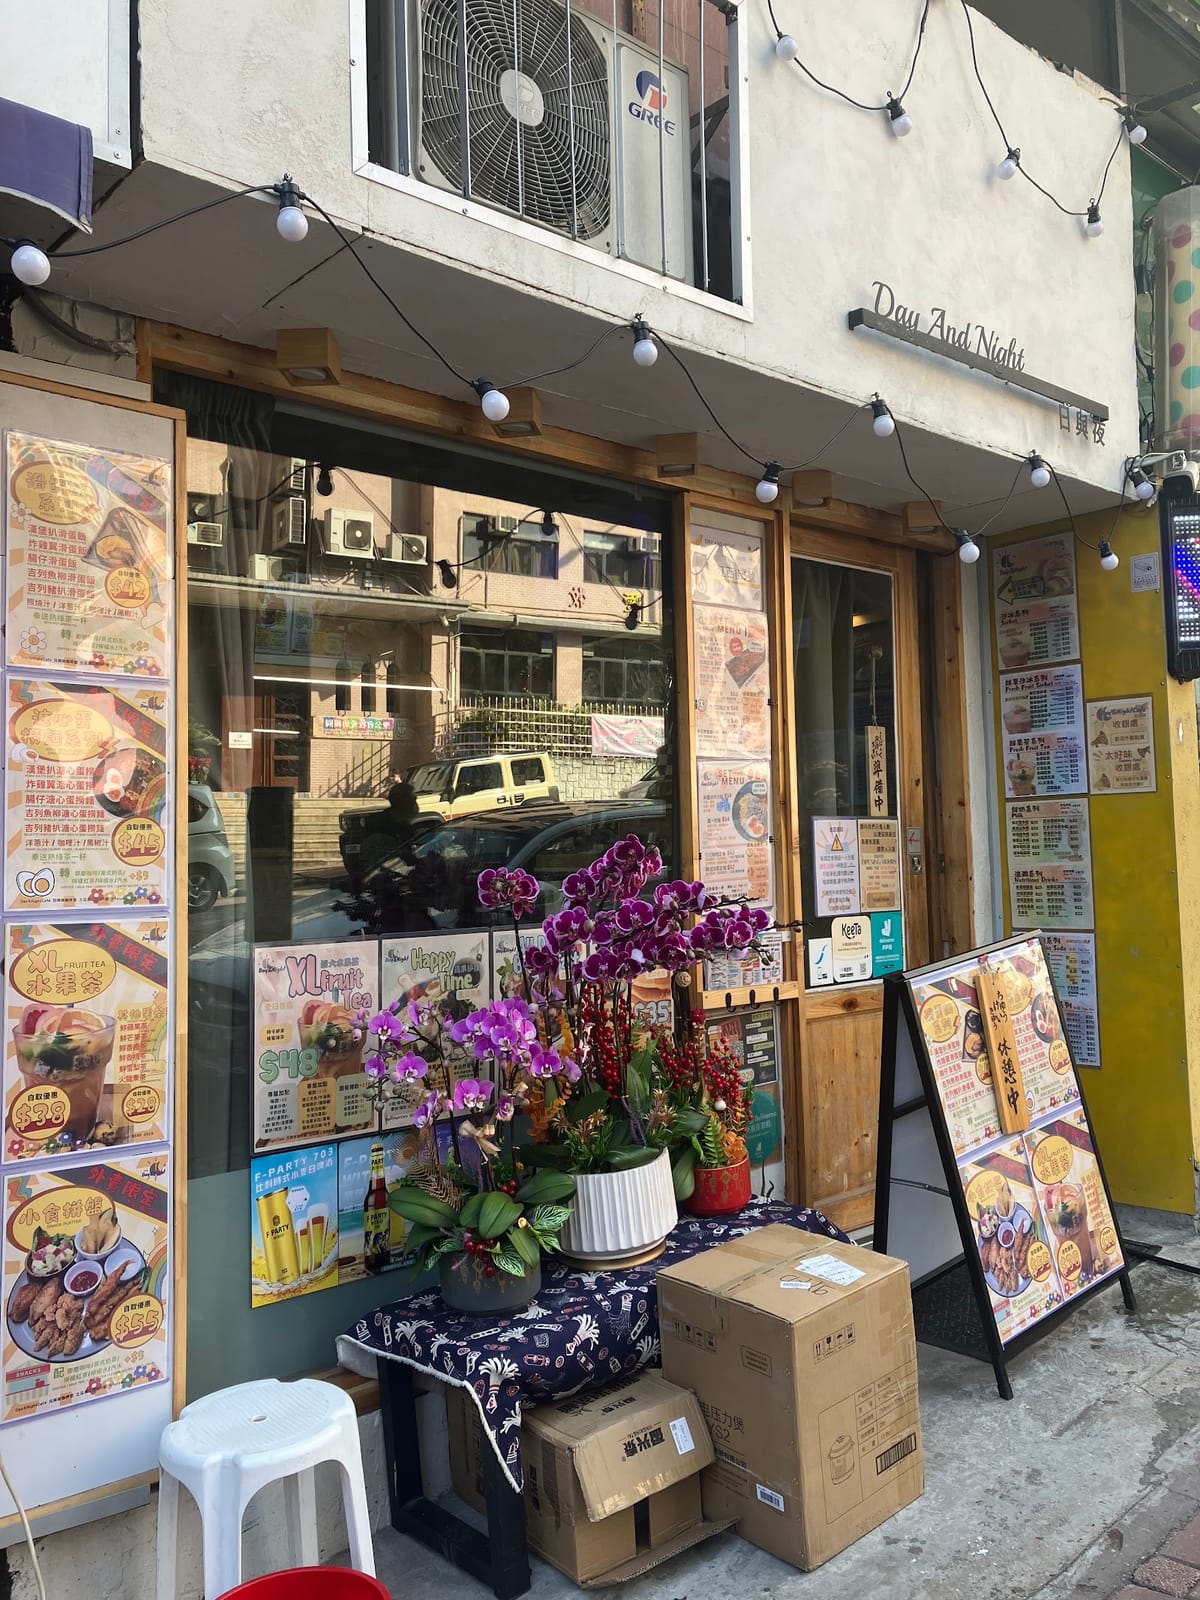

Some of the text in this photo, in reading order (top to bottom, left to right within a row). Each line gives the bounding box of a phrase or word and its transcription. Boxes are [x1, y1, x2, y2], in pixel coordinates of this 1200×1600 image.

[628, 101, 676, 136] GREE
[872, 281, 1025, 373] Day And Night
[1058, 403, 1106, 447] 日與夜
[119, 832, 160, 858] $45
[27, 950, 107, 974] XL FRUIT TEA
[411, 946, 456, 974] Happy
[26, 971, 102, 996] 水果茶
[284, 953, 323, 998] XL
[320, 968, 364, 992] Fruit
[437, 970, 474, 993] Time
[341, 989, 373, 1012] Tea
[259, 1047, 319, 1084] $48
[998, 1038, 1020, 1116] 休憩中
[16, 1103, 65, 1130] $38
[126, 1097, 156, 1115] $28
[255, 1148, 333, 1182] F-PARTY 703
[88, 1166, 159, 1206] 外賣限定
[18, 1196, 104, 1227] 小食拼盤
[370, 1211, 387, 1222] PARTY
[271, 1223, 290, 1237] PARTY
[115, 1309, 159, 1343] $55
[701, 1402, 745, 1434] 电压力煲
